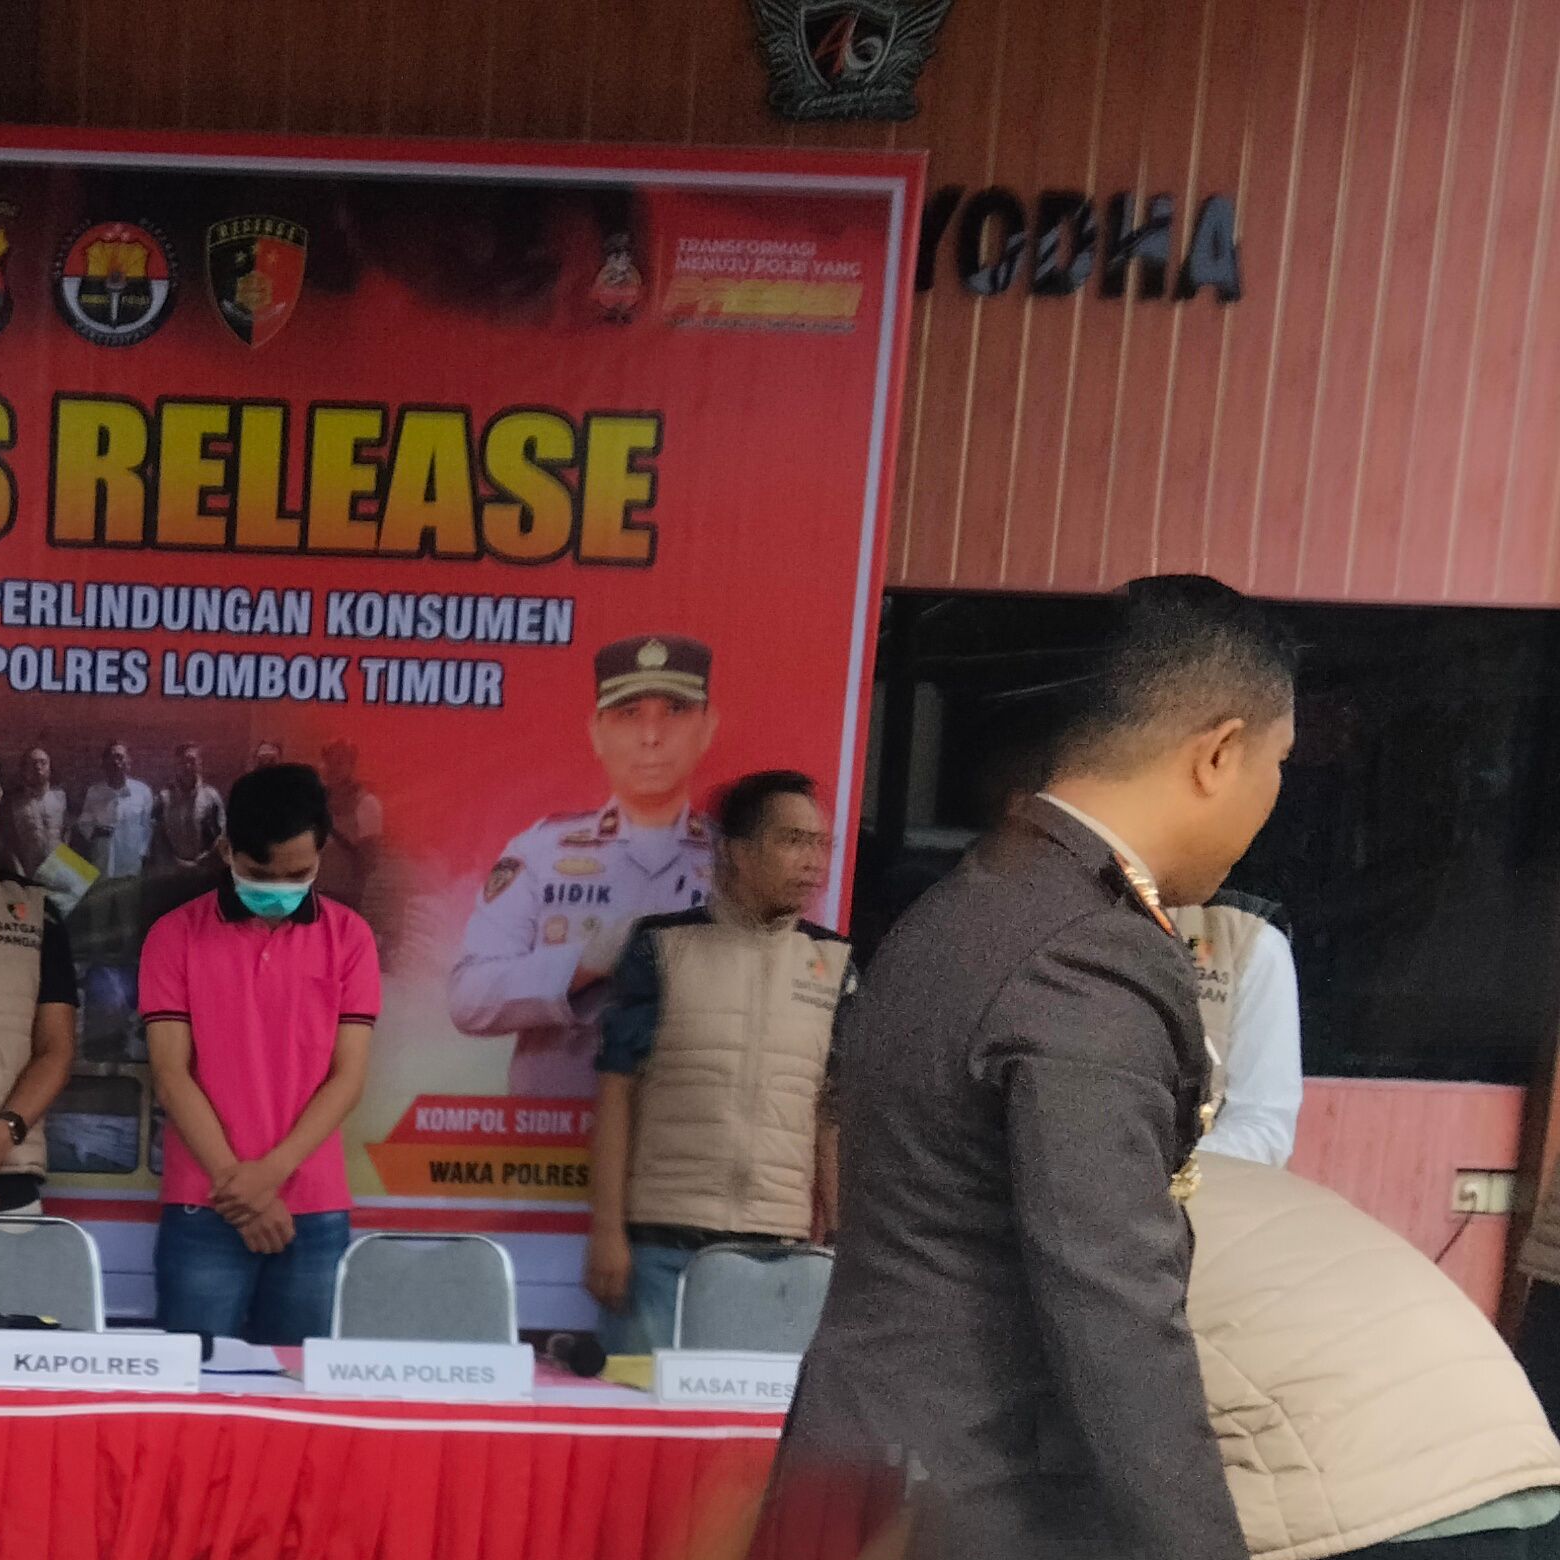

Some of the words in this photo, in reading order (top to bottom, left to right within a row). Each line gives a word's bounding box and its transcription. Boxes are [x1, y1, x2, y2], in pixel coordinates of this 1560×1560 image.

[679, 238, 817, 257] TRANSFORMASI
[675, 256, 750, 273] MENUJU
[812, 260, 863, 278] YANG
[47, 389, 665, 567] RELEASE
[326, 591, 574, 645] KONSUMEN
[162, 649, 348, 703] LOMBOK
[361, 656, 505, 708] TIMUR
[543, 883, 612, 904] SIDIK
[415, 1107, 506, 1133] KOMPOL
[514, 1109, 573, 1135] SIDIK
[429, 1160, 494, 1185] WAKA
[502, 1162, 590, 1187] POLRES
[13, 1351, 161, 1377] KAPOLRES
[327, 1361, 397, 1384] WAKA
[401, 1363, 497, 1387] POLRES
[678, 1376, 748, 1397] KASAT
